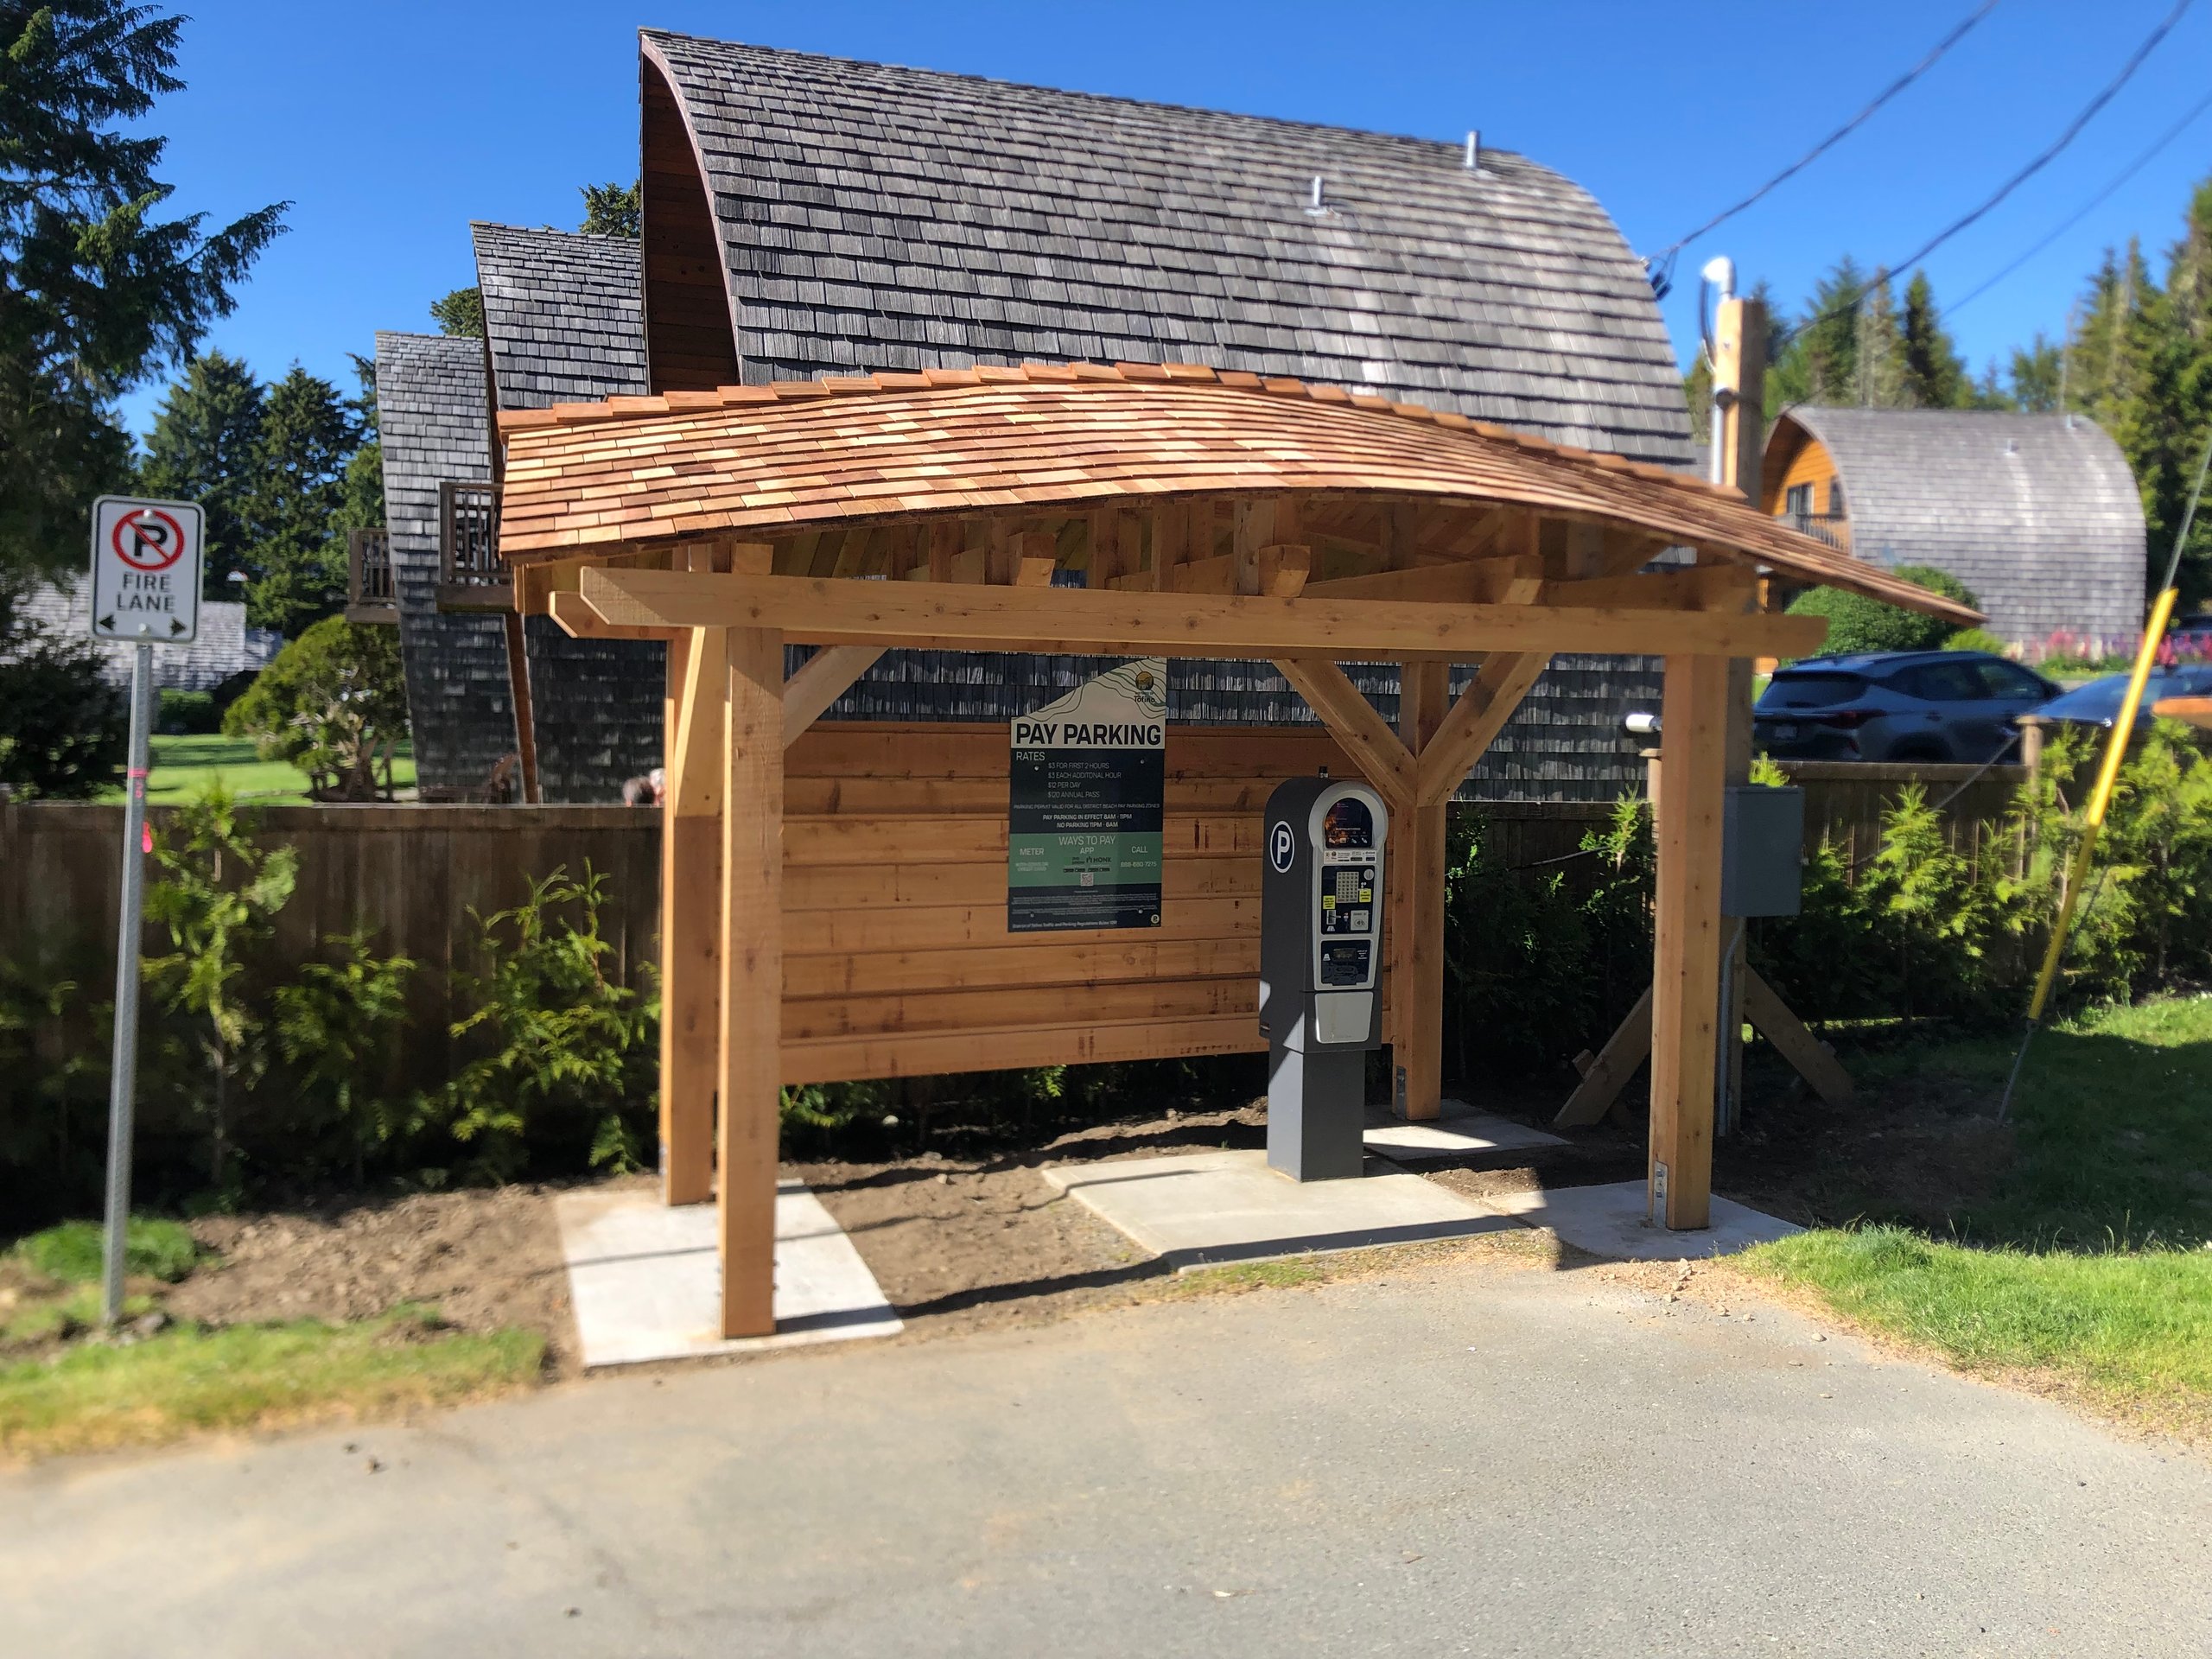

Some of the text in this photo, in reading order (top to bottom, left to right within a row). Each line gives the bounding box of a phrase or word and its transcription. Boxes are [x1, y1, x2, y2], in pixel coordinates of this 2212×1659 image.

[123, 573, 171, 593] FIRE
[117, 592, 175, 613] LANE
[1016, 723, 1161, 745] PAY PARKING
[1016, 751, 1045, 761] RATES
[1059, 836, 1115, 845] WAYS TO PAY
[1277, 830, 1290, 864] P
